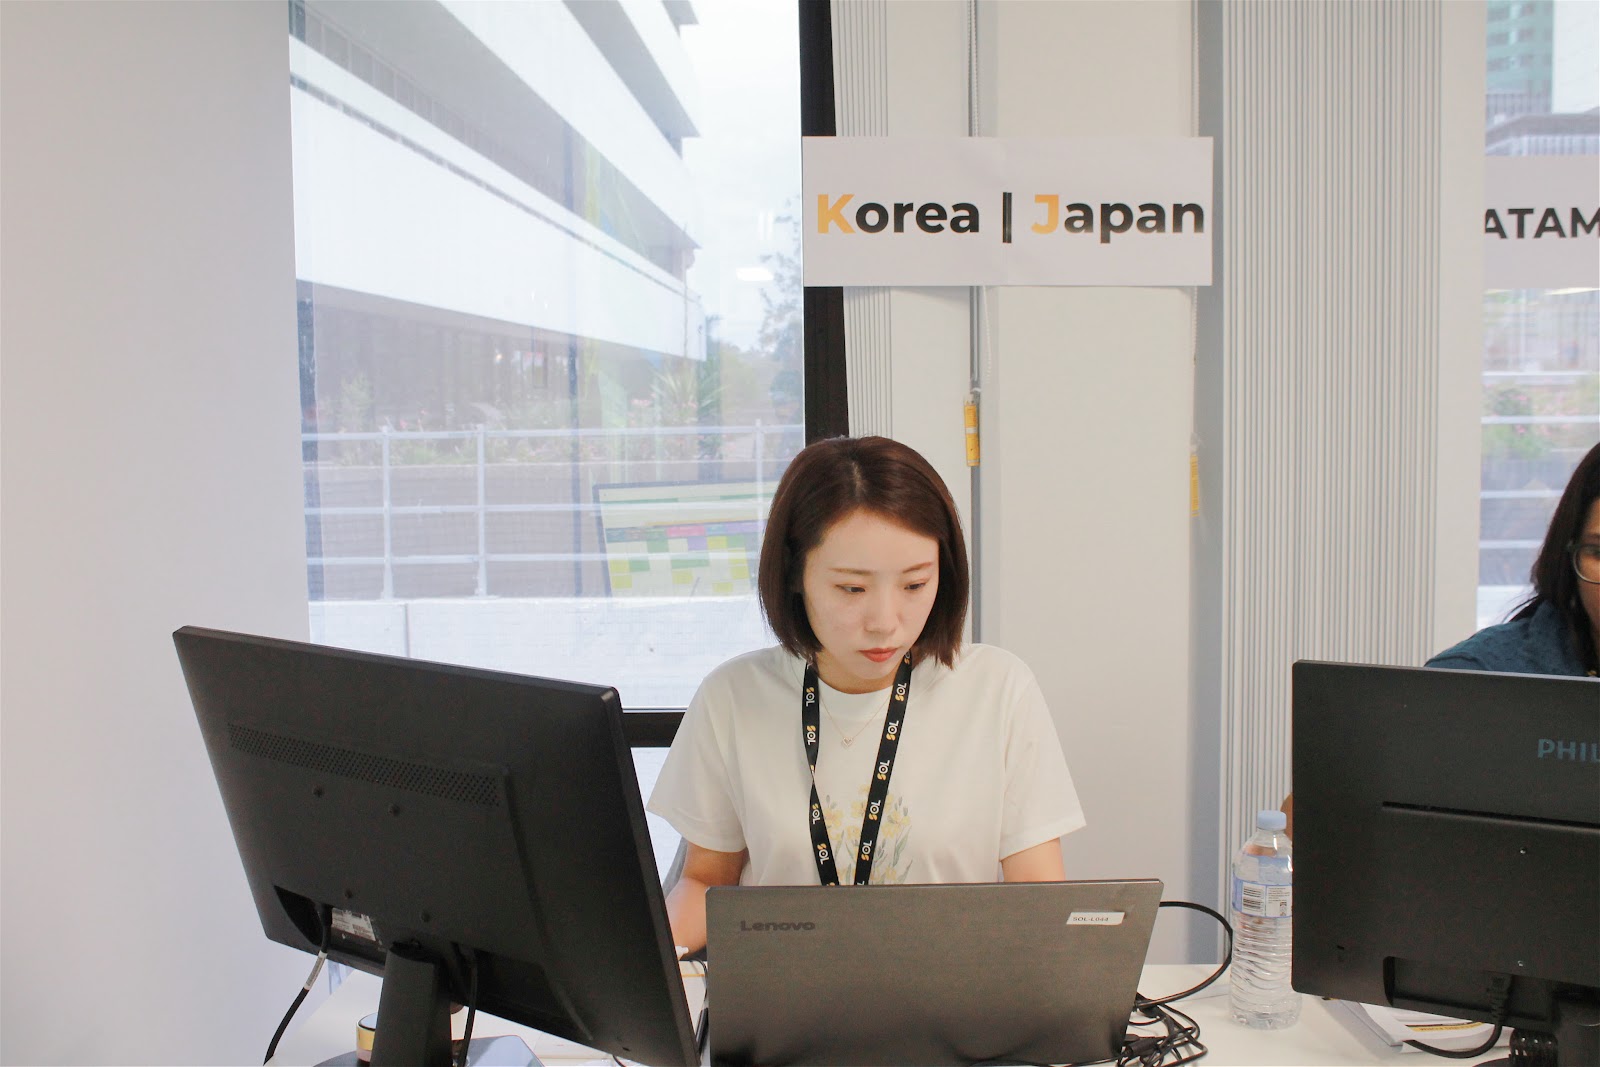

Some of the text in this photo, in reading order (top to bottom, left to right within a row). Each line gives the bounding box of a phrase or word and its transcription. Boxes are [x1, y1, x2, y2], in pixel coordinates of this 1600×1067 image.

[817, 194, 979, 233] Korea
[1032, 194, 1205, 244] Japan
[806, 687, 815, 706] SOL
[895, 682, 907, 702] SOL
[807, 725, 816, 745] SOL
[886, 720, 899, 741] SOL
[1537, 738, 1600, 762] PHIL
[877, 760, 890, 781] SOL
[812, 803, 820, 825] SOL
[869, 799, 881, 821] SOL
[817, 843, 830, 865] SOL
[861, 839, 872, 862] SOL
[740, 920, 815, 932] Lenovo
